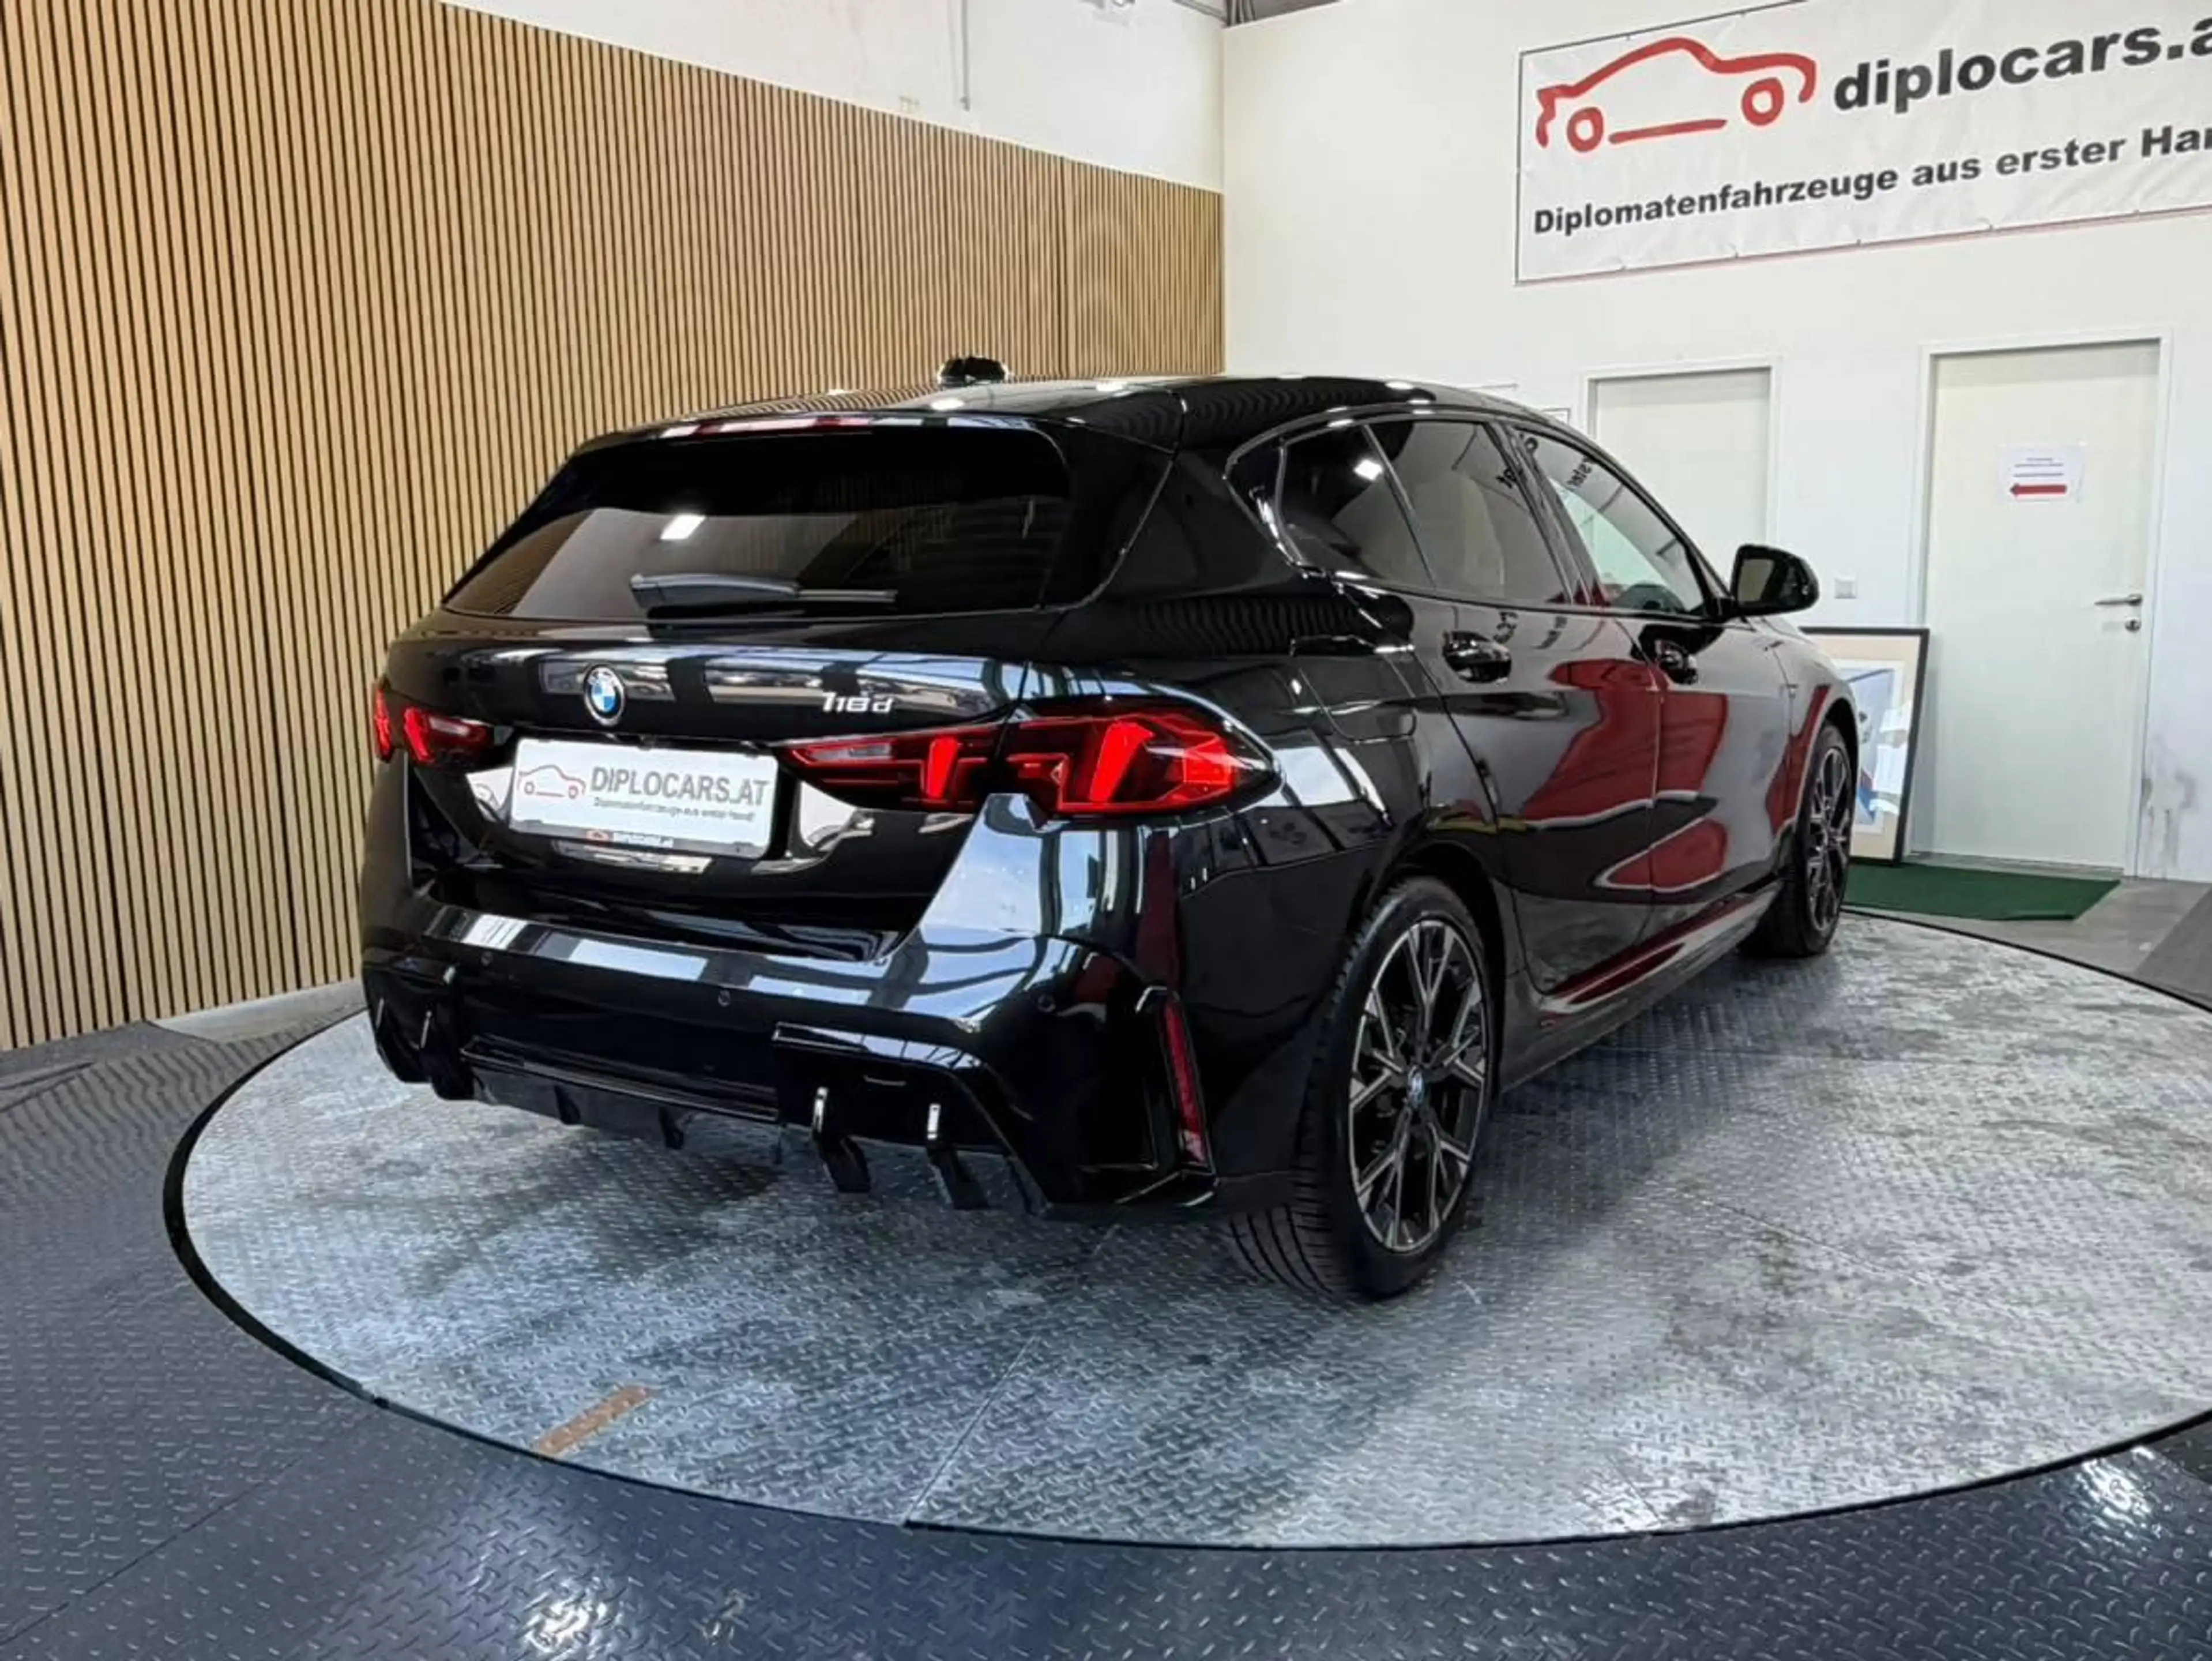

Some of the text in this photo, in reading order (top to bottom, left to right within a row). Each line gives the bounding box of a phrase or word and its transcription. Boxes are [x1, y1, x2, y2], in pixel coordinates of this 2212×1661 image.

[1534, 170, 1898, 236] Diplomatenfahrzeuge
[1912, 158, 1981, 186] aus
[1996, 139, 2126, 175] erster
[591, 766, 769, 806] DIPLOCARS.AT
